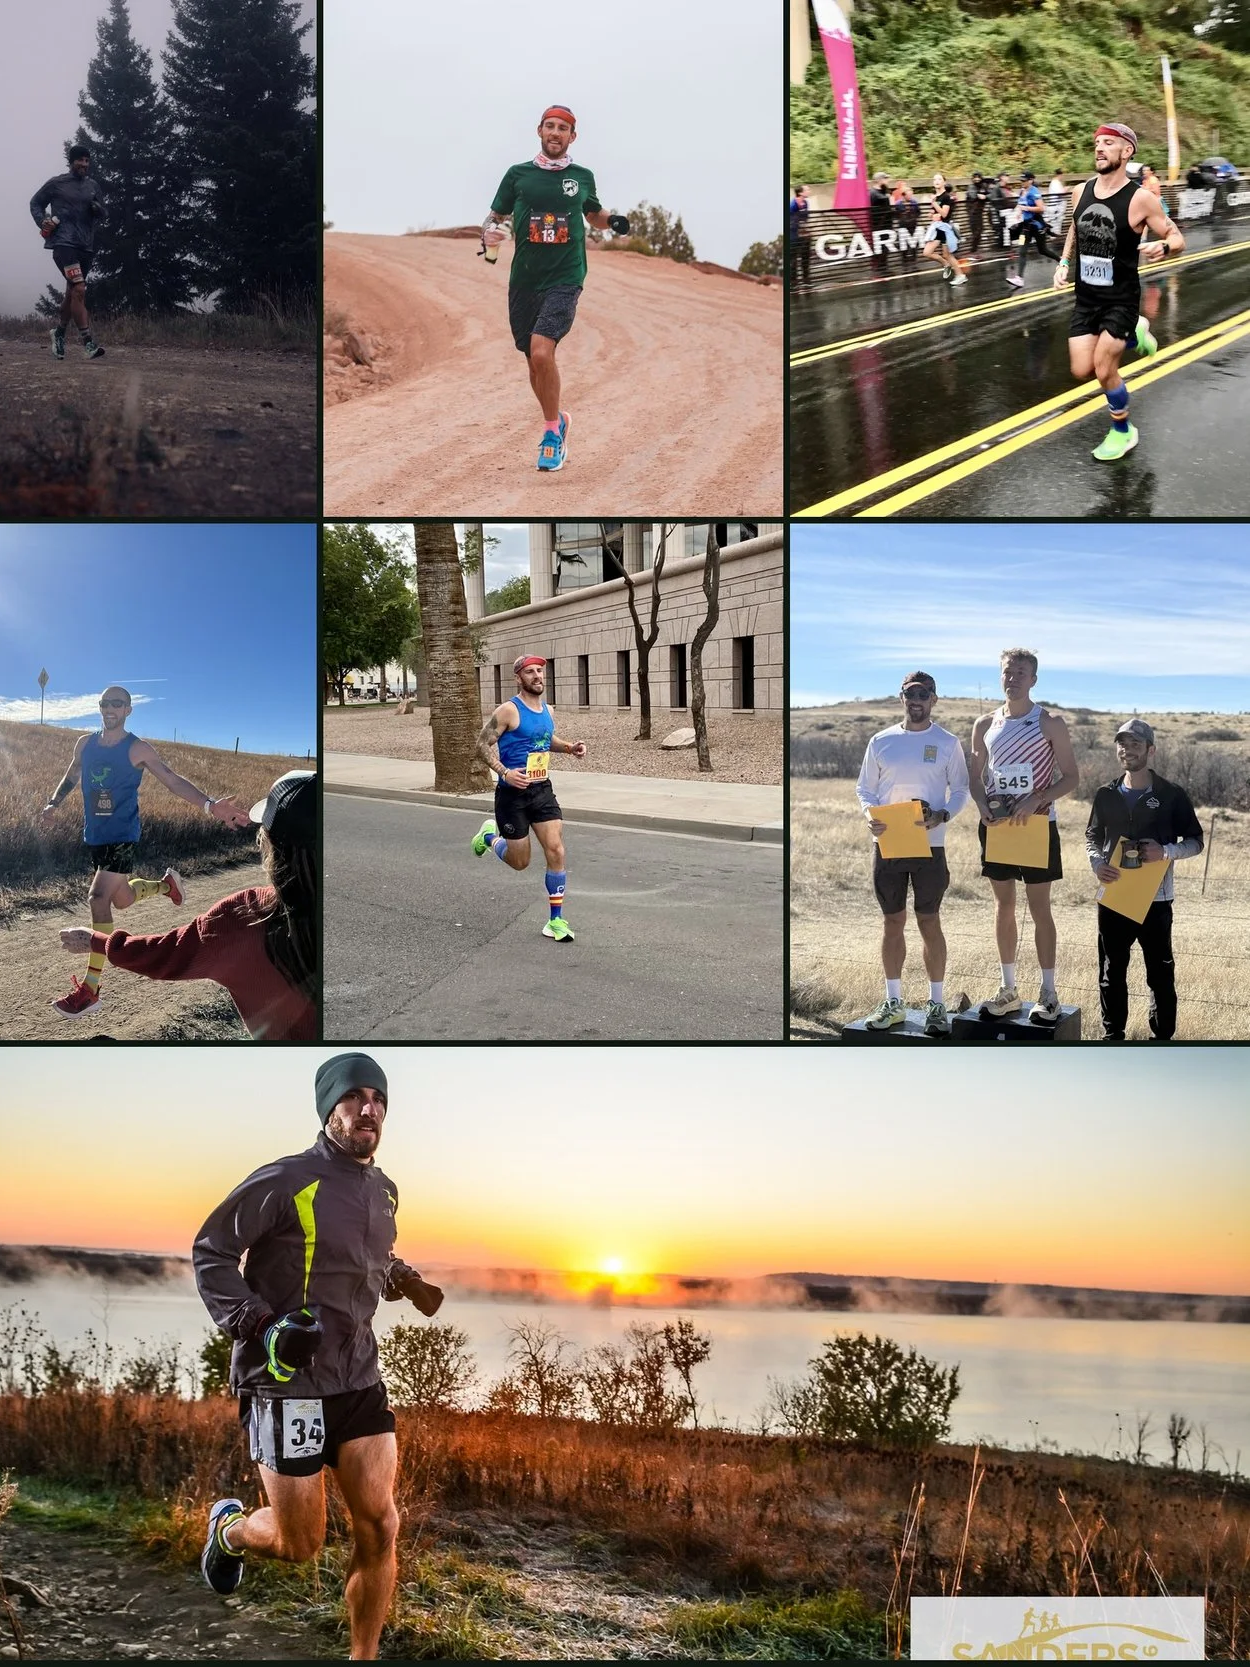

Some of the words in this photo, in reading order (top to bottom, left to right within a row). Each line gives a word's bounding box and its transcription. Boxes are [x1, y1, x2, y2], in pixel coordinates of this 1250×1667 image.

[542, 229, 555, 242] 13
[526, 768, 547, 779] 3100
[998, 775, 1030, 790] 545
[97, 799, 112, 809] 498
[291, 1418, 324, 1447] 34
